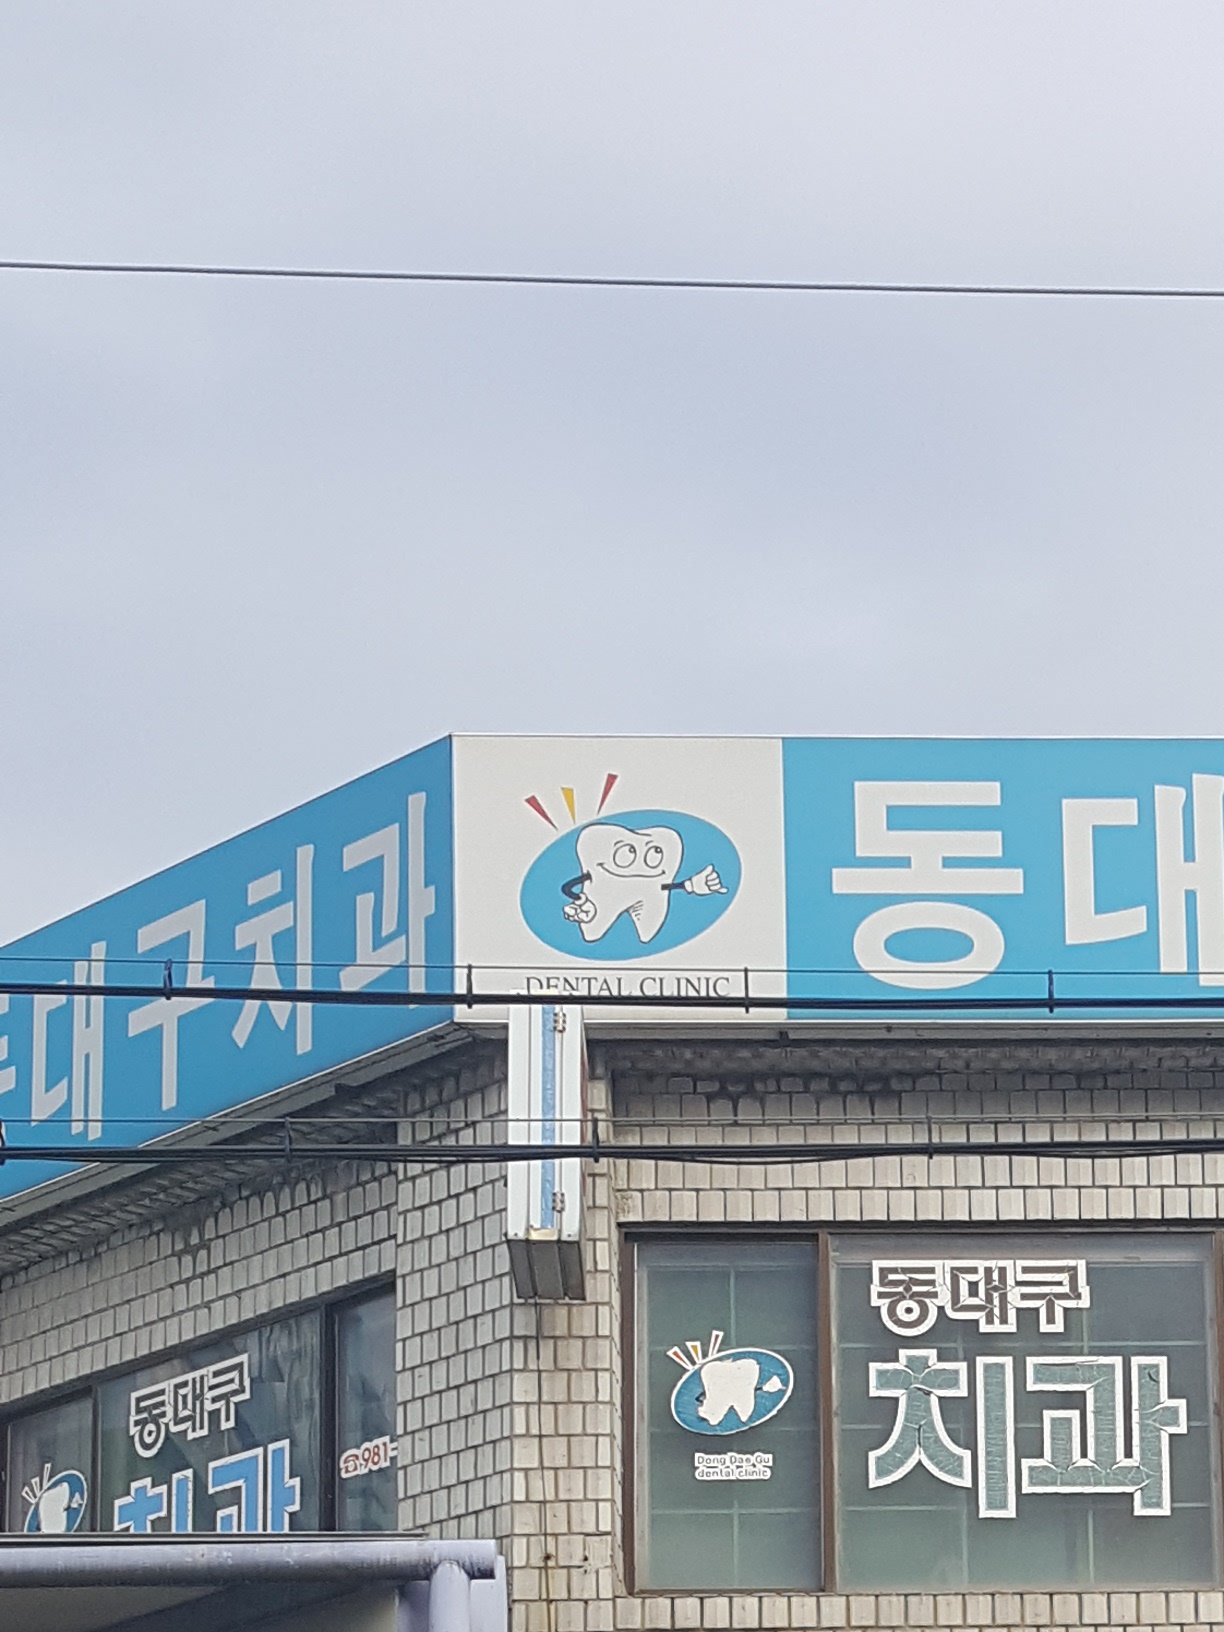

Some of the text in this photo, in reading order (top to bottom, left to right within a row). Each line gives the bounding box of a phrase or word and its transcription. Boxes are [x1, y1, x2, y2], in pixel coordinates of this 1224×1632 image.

[0, 791, 436, 1141] 대구치과
[525, 975, 731, 998] DENTAL CLINIC
[872, 1260, 1089, 1335] 동대구
[130, 1353, 250, 1457] 동대구
[869, 1349, 1187, 1519] 치과
[696, 1454, 727, 1467] Dong
[729, 1454, 753, 1465] Dae
[696, 1468, 770, 1479] dental clinic
